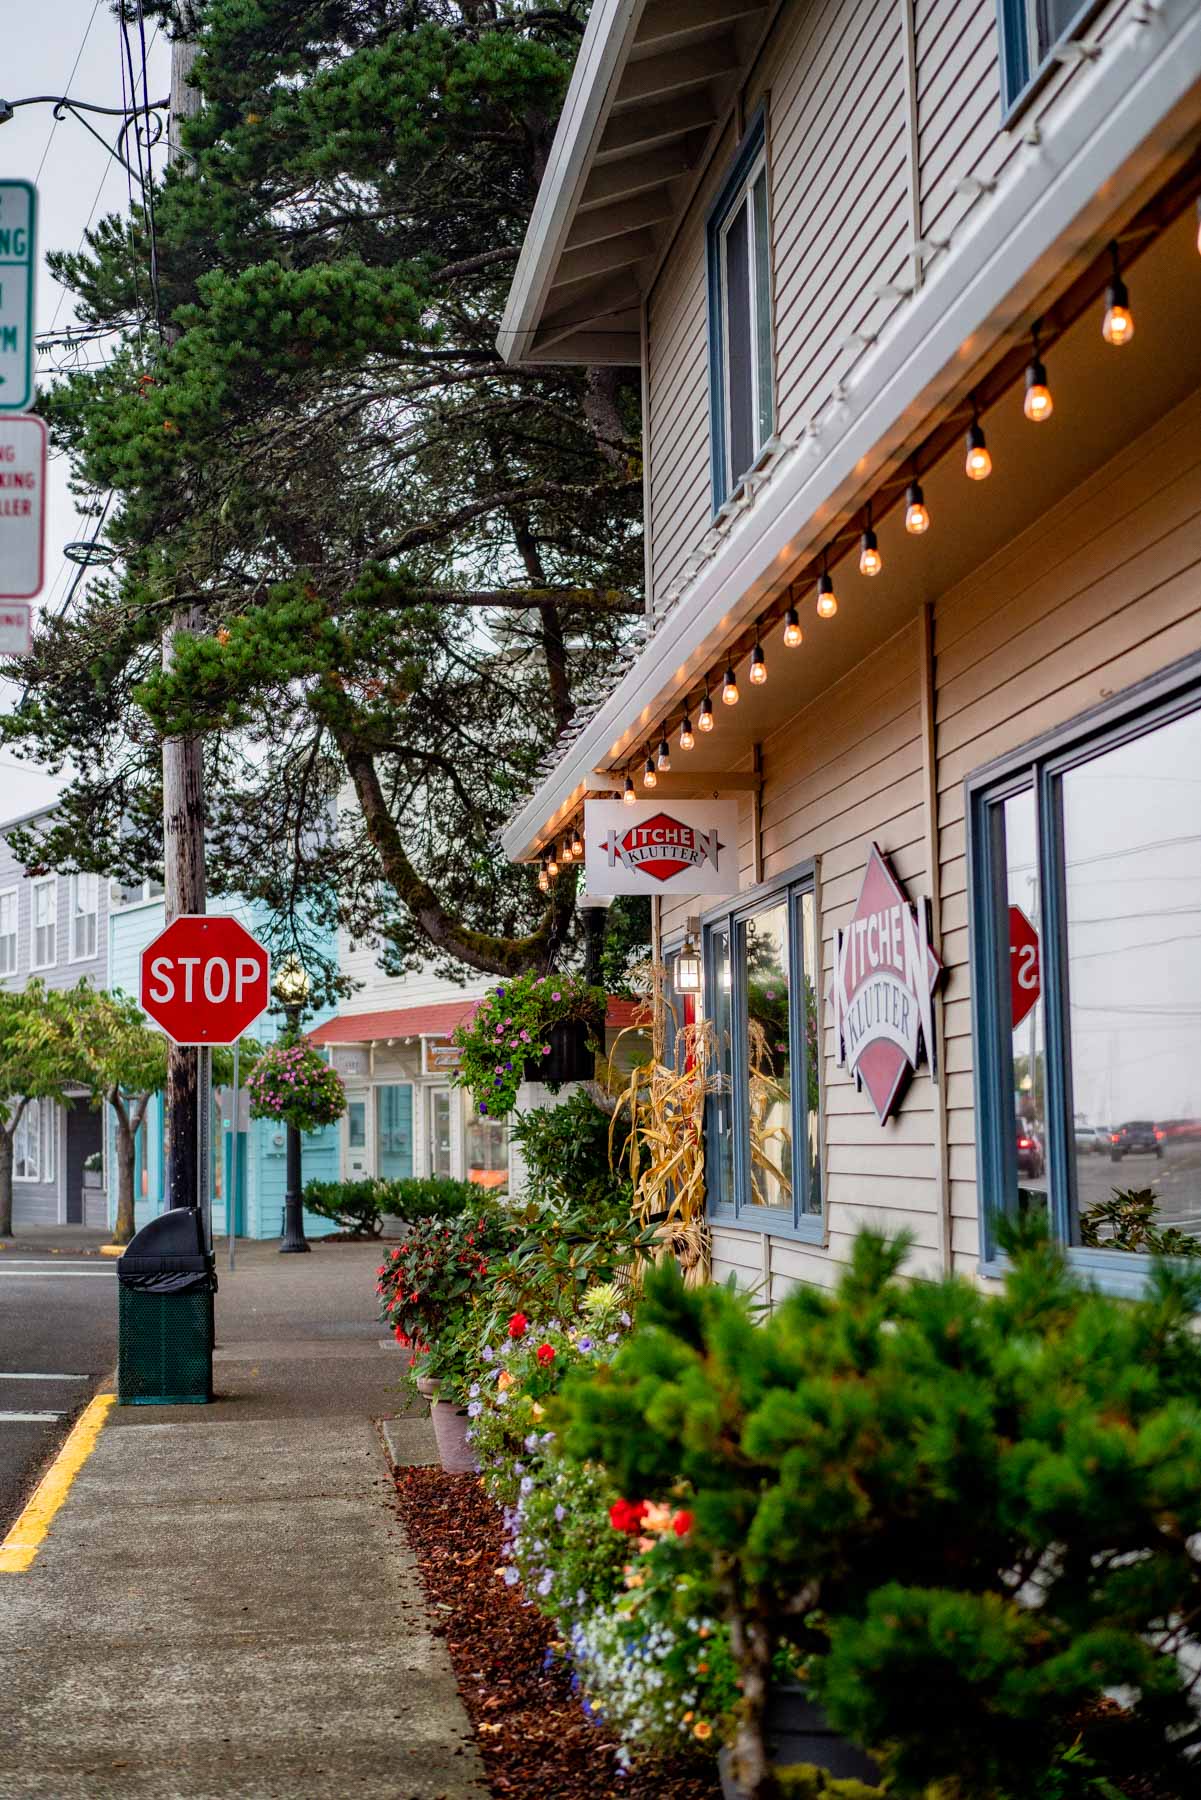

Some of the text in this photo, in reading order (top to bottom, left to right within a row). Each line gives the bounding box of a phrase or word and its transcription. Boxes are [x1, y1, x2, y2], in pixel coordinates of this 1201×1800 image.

[608, 828, 719, 873] KITCHEN
[628, 845, 699, 863] KLUTTER
[149, 956, 261, 1004] STOP
[833, 895, 937, 1084] KITCHEN
[848, 981, 910, 1049] KLUTTER
